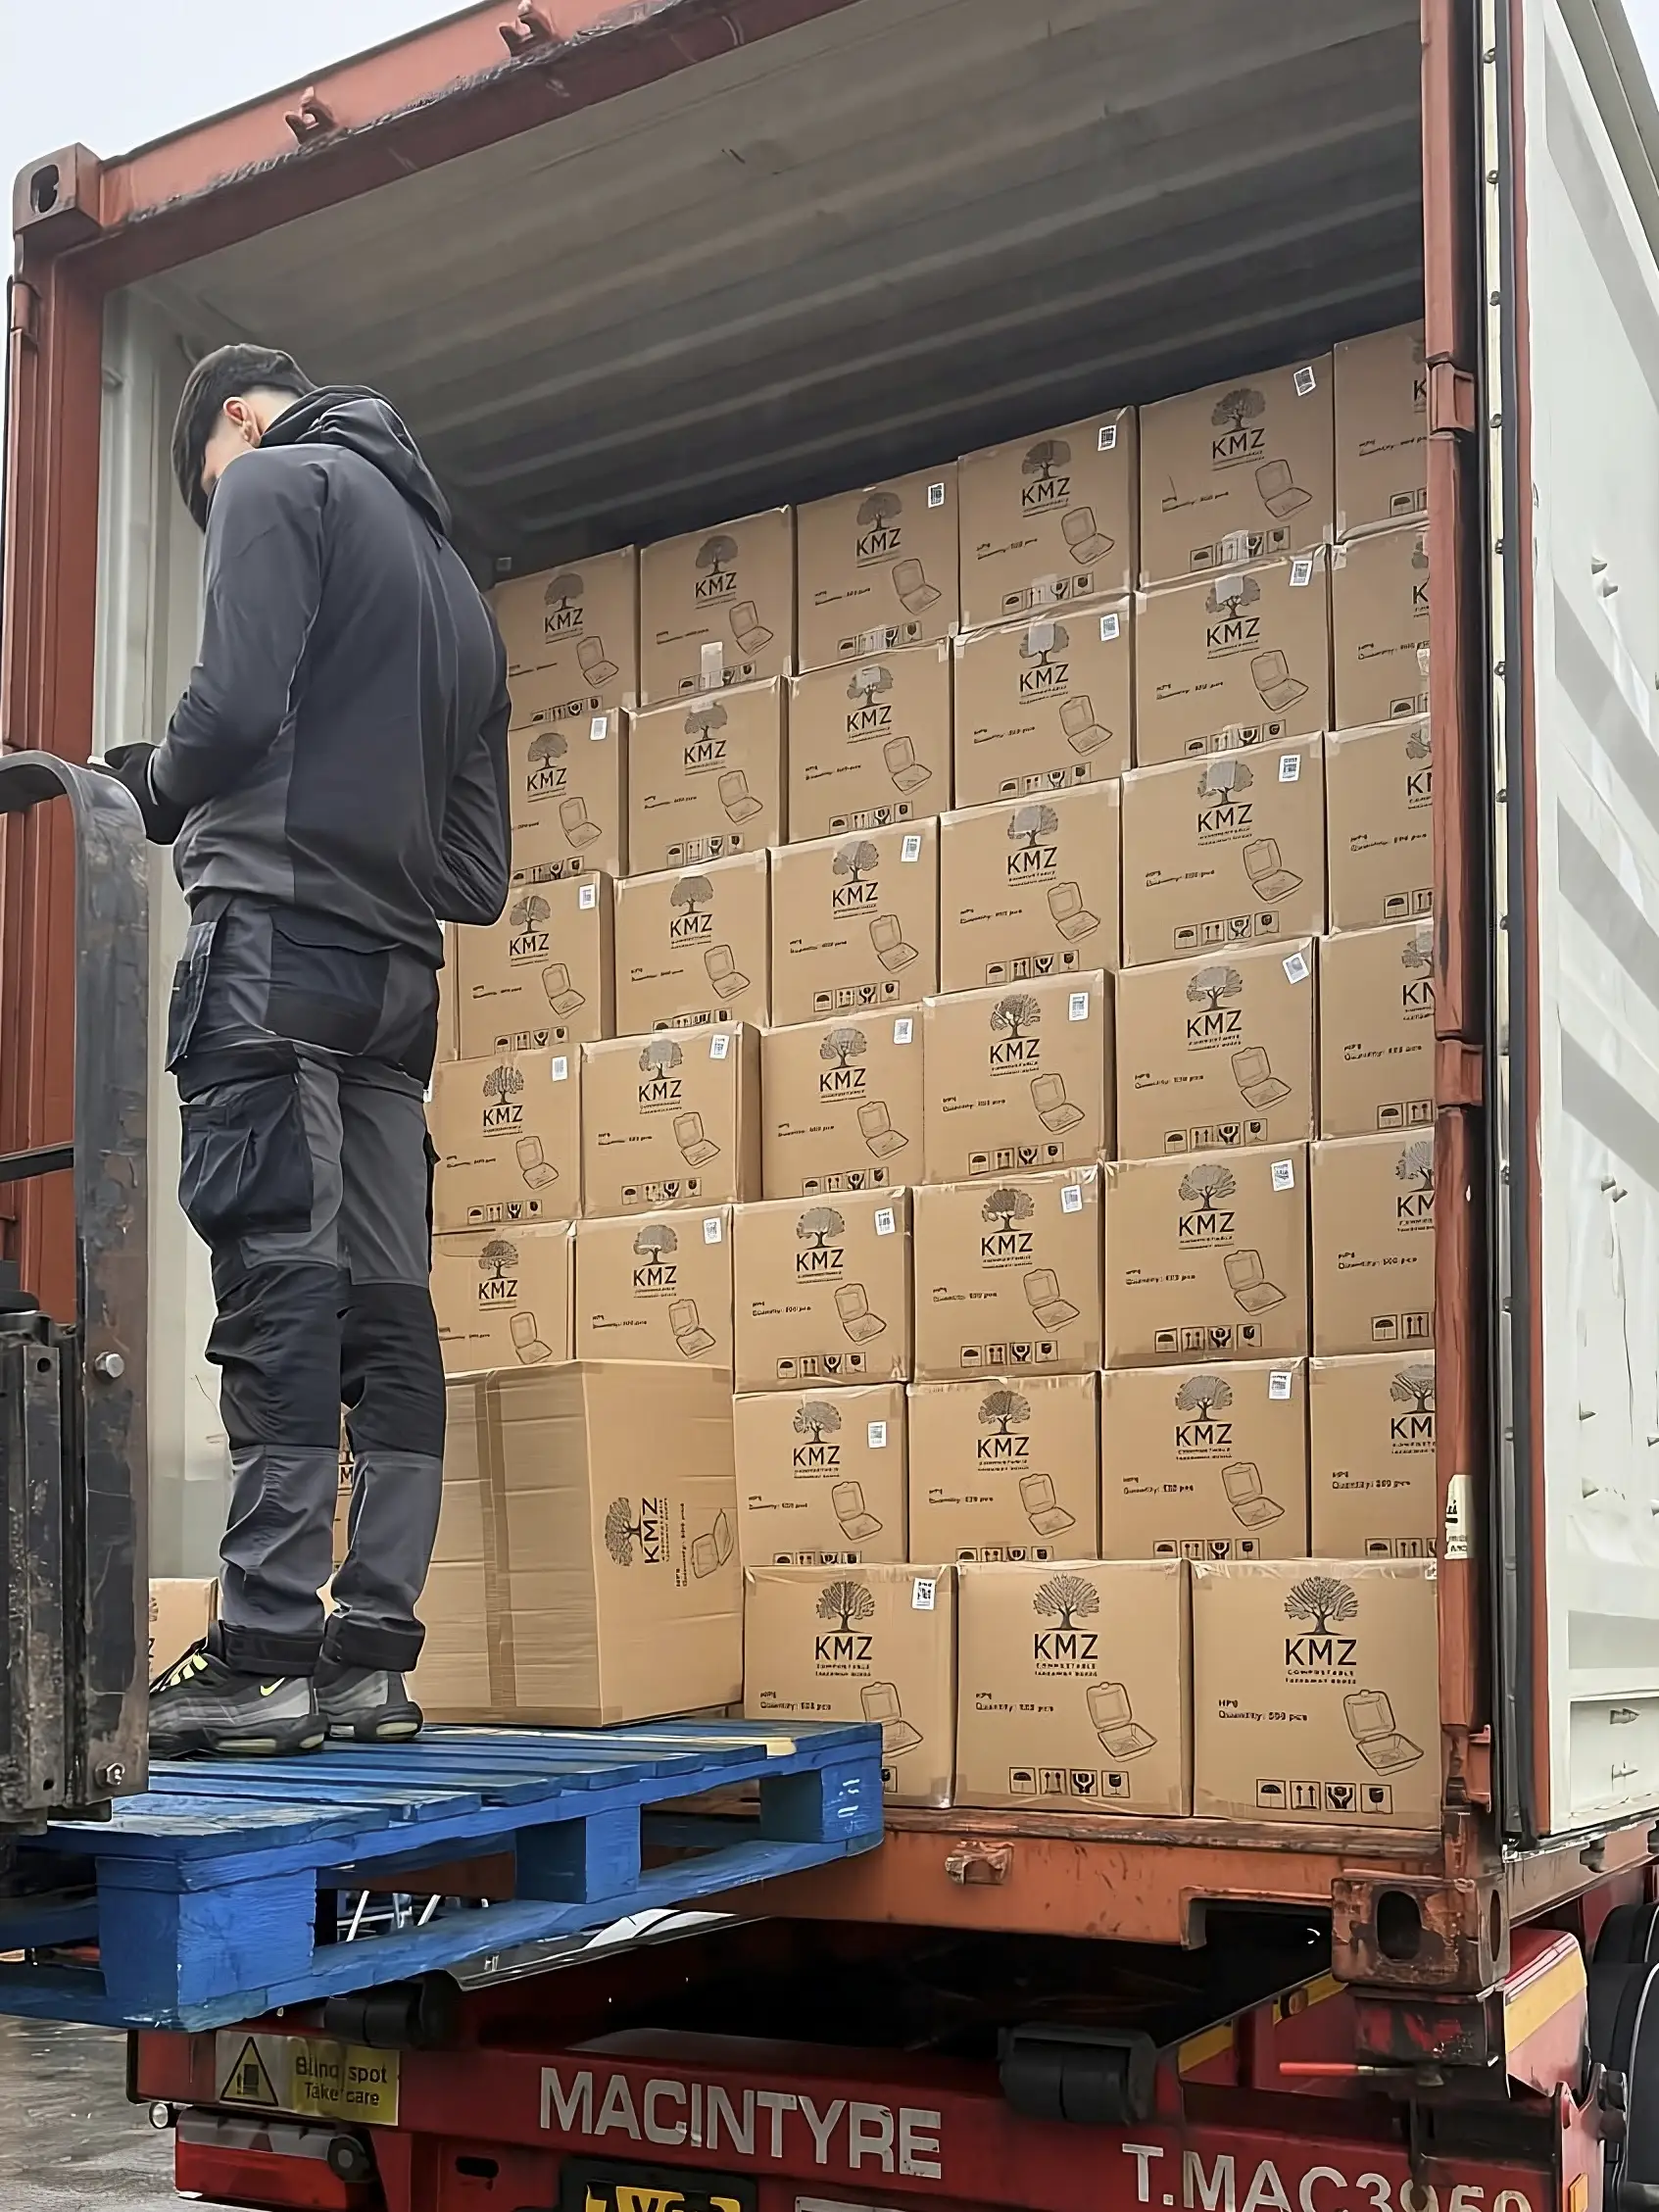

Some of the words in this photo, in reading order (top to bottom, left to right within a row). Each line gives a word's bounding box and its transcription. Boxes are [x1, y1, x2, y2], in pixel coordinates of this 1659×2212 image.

[1213, 428, 1264, 459] KMZ
[1022, 477, 1070, 506] KMZ
[857, 528, 901, 556] KMZ
[696, 572, 736, 597] KMZ
[546, 609, 582, 632] KMZ
[1207, 617, 1259, 647] KMZ
[1020, 664, 1068, 692] KMZ
[848, 706, 892, 732] KMZ
[685, 740, 726, 764] KMZ
[527, 768, 566, 791] KMZ
[1198, 804, 1252, 832] KMZ
[1008, 847, 1057, 874] KMZ
[833, 882, 878, 907] KMZ
[671, 914, 712, 937] KMZ
[510, 934, 549, 956] KMZ
[1188, 1010, 1242, 1038] KMZ
[991, 1039, 1040, 1063] KMZ
[639, 1080, 681, 1102] KMZ
[820, 1068, 865, 1092] KMZ
[484, 1106, 522, 1126] KMZ
[1398, 1195, 1435, 1217] KM
[1180, 1212, 1235, 1236] KMZ
[982, 1233, 1033, 1255] KMZ
[797, 1250, 844, 1271] KMZ
[634, 1266, 676, 1286] KMZ
[479, 1280, 517, 1299] KMZ
[1176, 1424, 1232, 1446] KMZ
[1391, 1416, 1432, 1439] KM
[794, 1446, 840, 1465] KMZ
[978, 1437, 1029, 1457] KMZ
[642, 1498, 659, 1564] KMZ
[815, 1637, 872, 1660] KMZ
[1035, 1634, 1098, 1659] KMZ
[1286, 1639, 1356, 1665] KMZ
[348, 2063, 387, 2084] spot
[304, 2081, 339, 2101] Take
[346, 2089, 380, 2106] care
[541, 2067, 942, 2180] MACINTYRE
